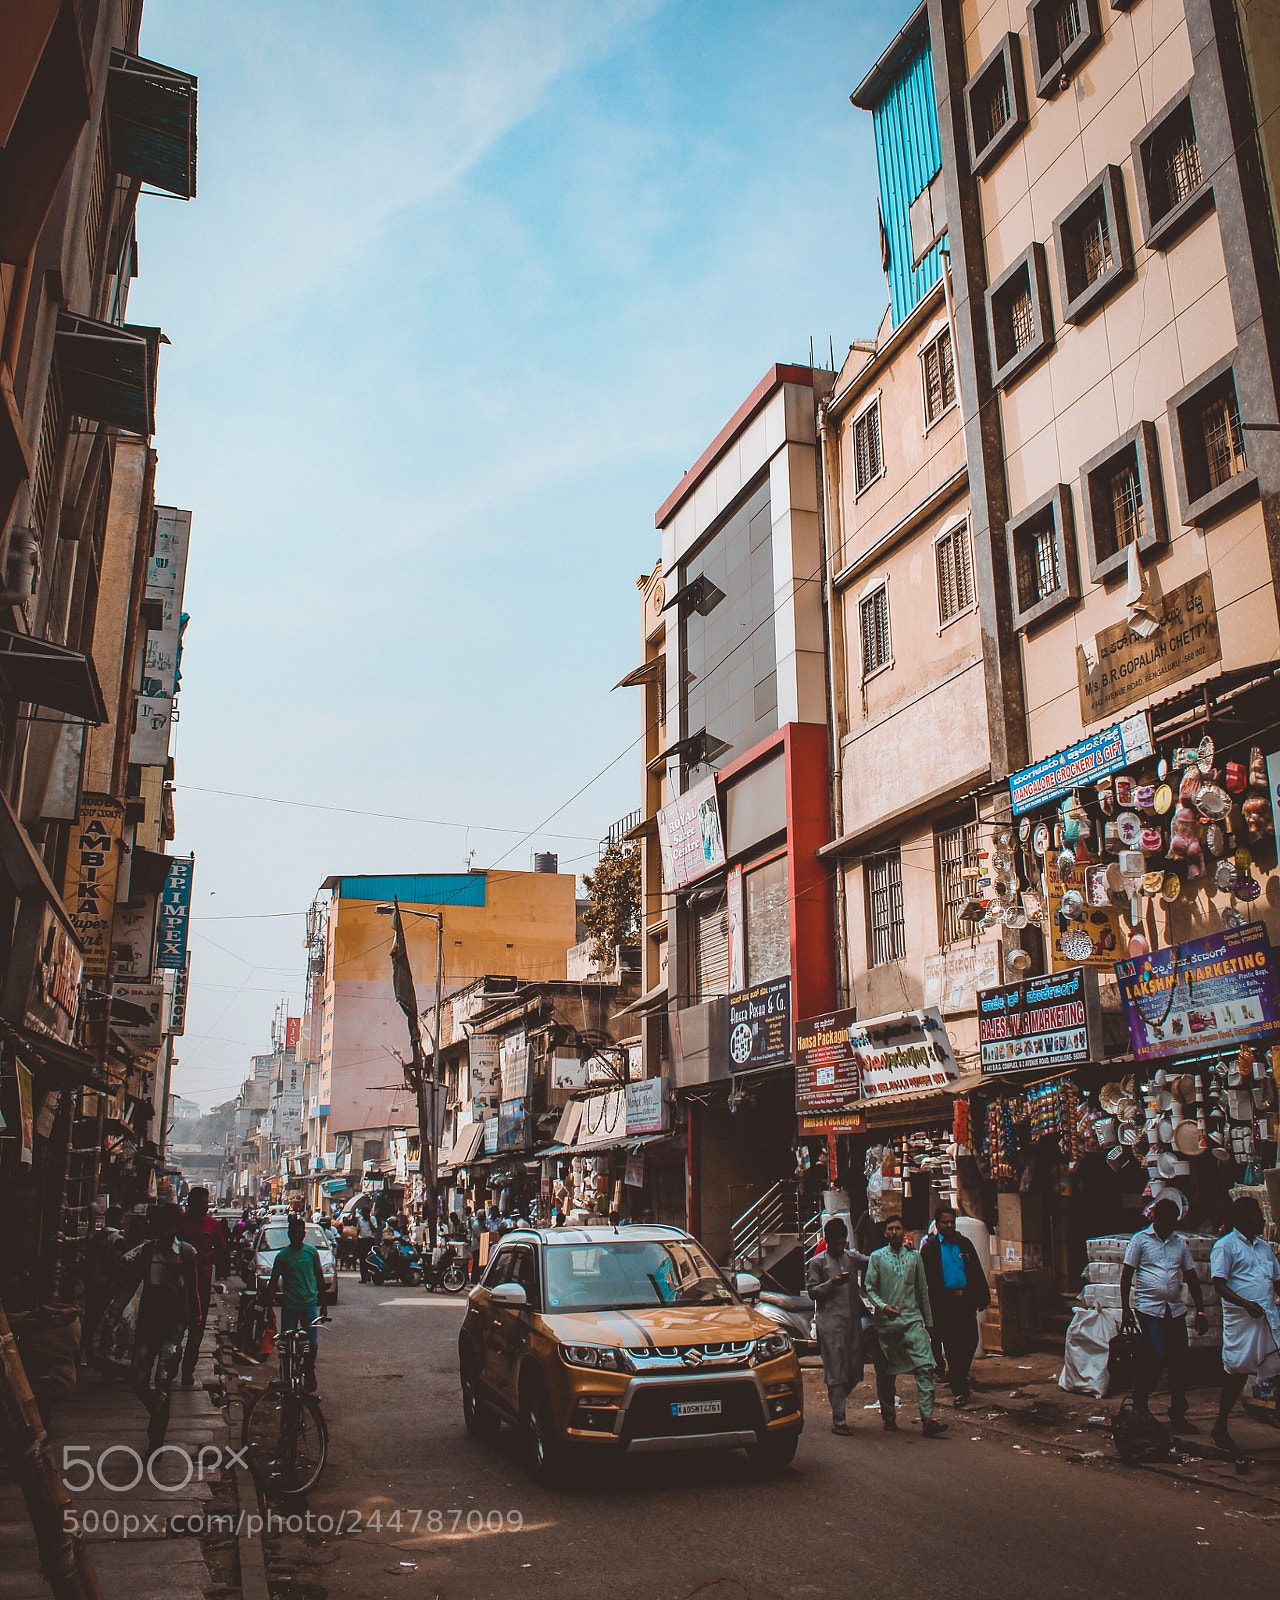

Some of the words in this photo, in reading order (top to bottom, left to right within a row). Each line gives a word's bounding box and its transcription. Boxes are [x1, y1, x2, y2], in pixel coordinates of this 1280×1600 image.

[1085, 681, 1101, 696] M/s.
[1102, 642, 1167, 687] B.R.GOPALIAH
[1169, 620, 1209, 651] CHETTY
[1104, 688, 1126, 704] AVENUE
[1145, 661, 1180, 682] BENGALURU
[1013, 772, 1056, 803] MANGALORE
[1055, 750, 1095, 783] CROCKERY
[1096, 750, 1104, 764] &
[1104, 740, 1122, 761] GIFT
[668, 807, 698, 834] ROYAL
[673, 826, 696, 846] Saree
[673, 838, 700, 860] Centre
[77, 819, 112, 915] AMBIKA
[68, 913, 108, 934] Paper
[162, 892, 188, 955] IMPEX
[1126, 973, 1181, 999] LAKSHMI
[1184, 951, 1266, 985] MARKETING
[767, 994, 774, 1014] &
[776, 992, 786, 1011] Co.
[1030, 1000, 1085, 1033] MARKETING
[289, 1019, 297, 1045] AJS
[797, 1035, 817, 1051] Hansa
[817, 1028, 848, 1047] Packagin
[824, 1114, 860, 1126] Packaging
[678, 1404, 720, 1414] KA05MT4761
